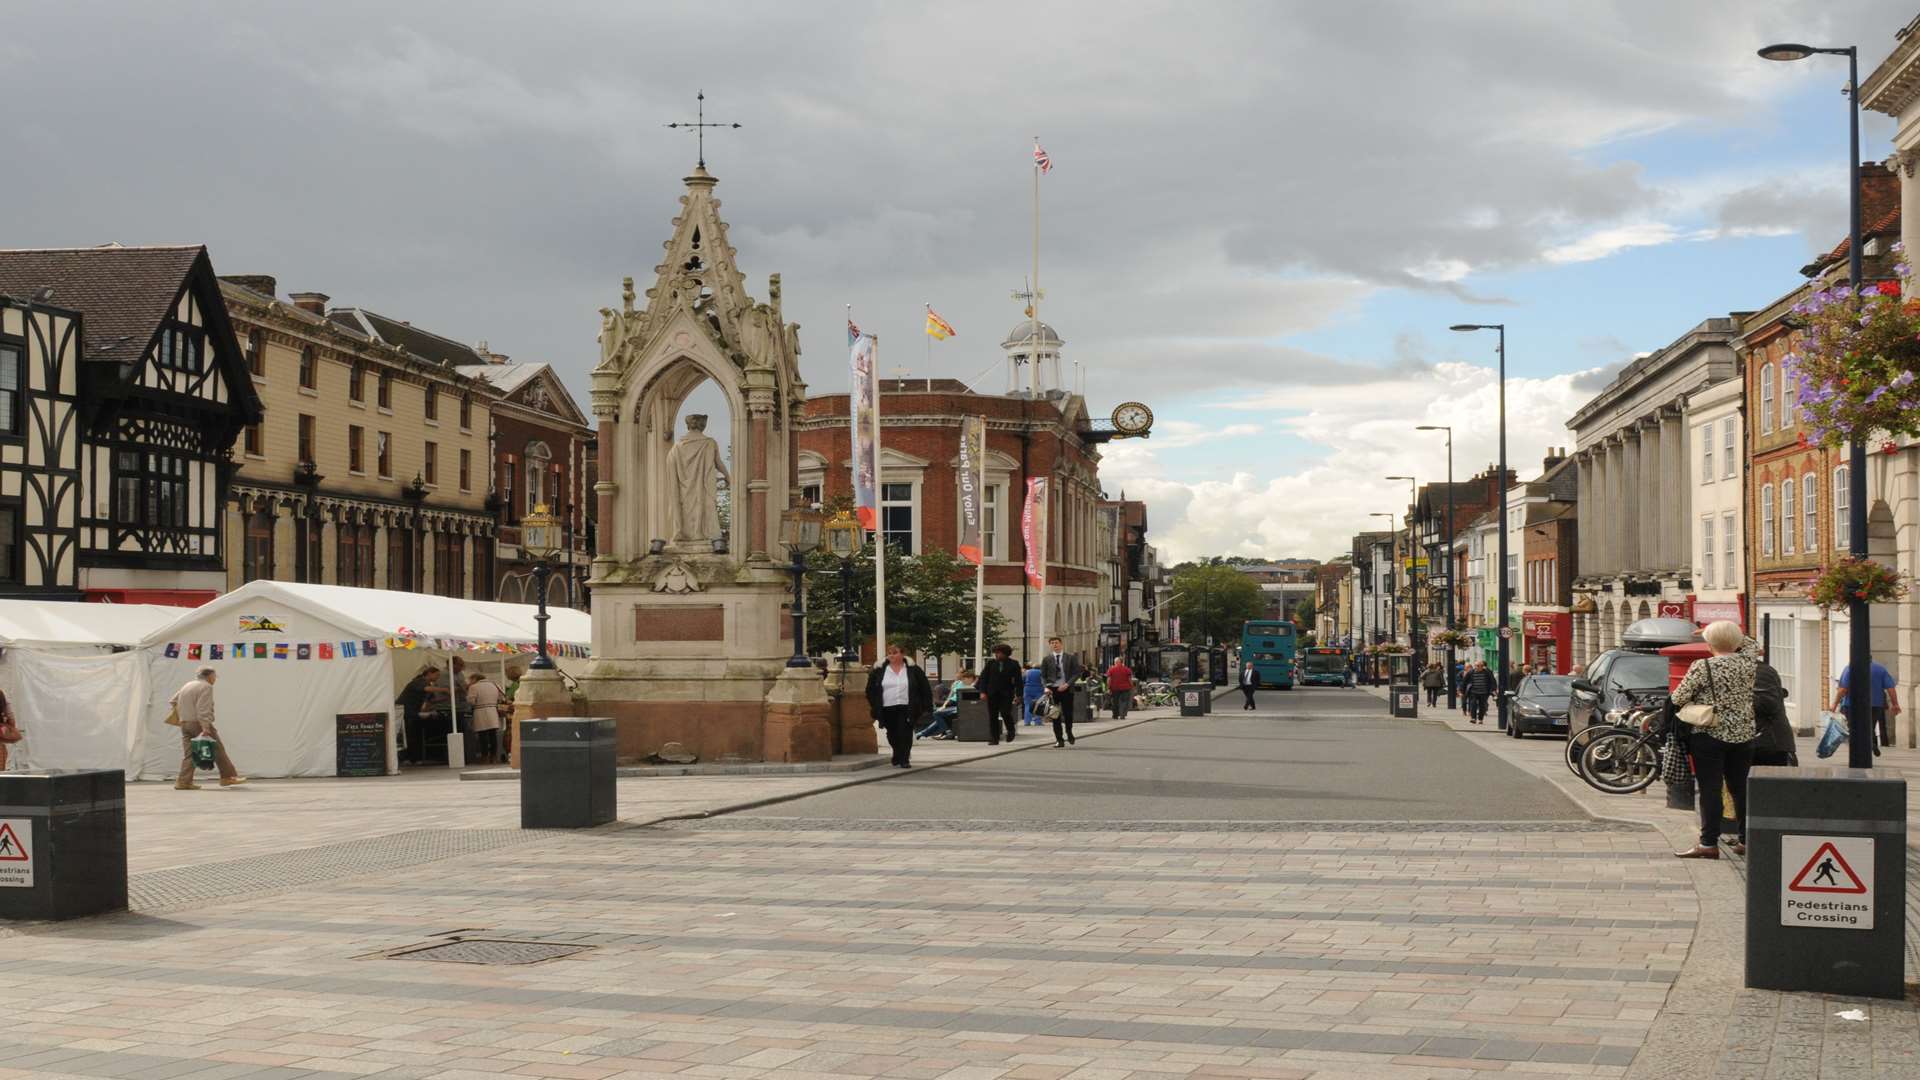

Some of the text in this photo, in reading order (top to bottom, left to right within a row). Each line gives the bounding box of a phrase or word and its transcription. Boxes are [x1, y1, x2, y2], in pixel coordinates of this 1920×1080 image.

[0, 876, 25, 884] ossing
[1787, 899, 1869, 912] Pedestrians
[1797, 912, 1858, 924] Crossing
